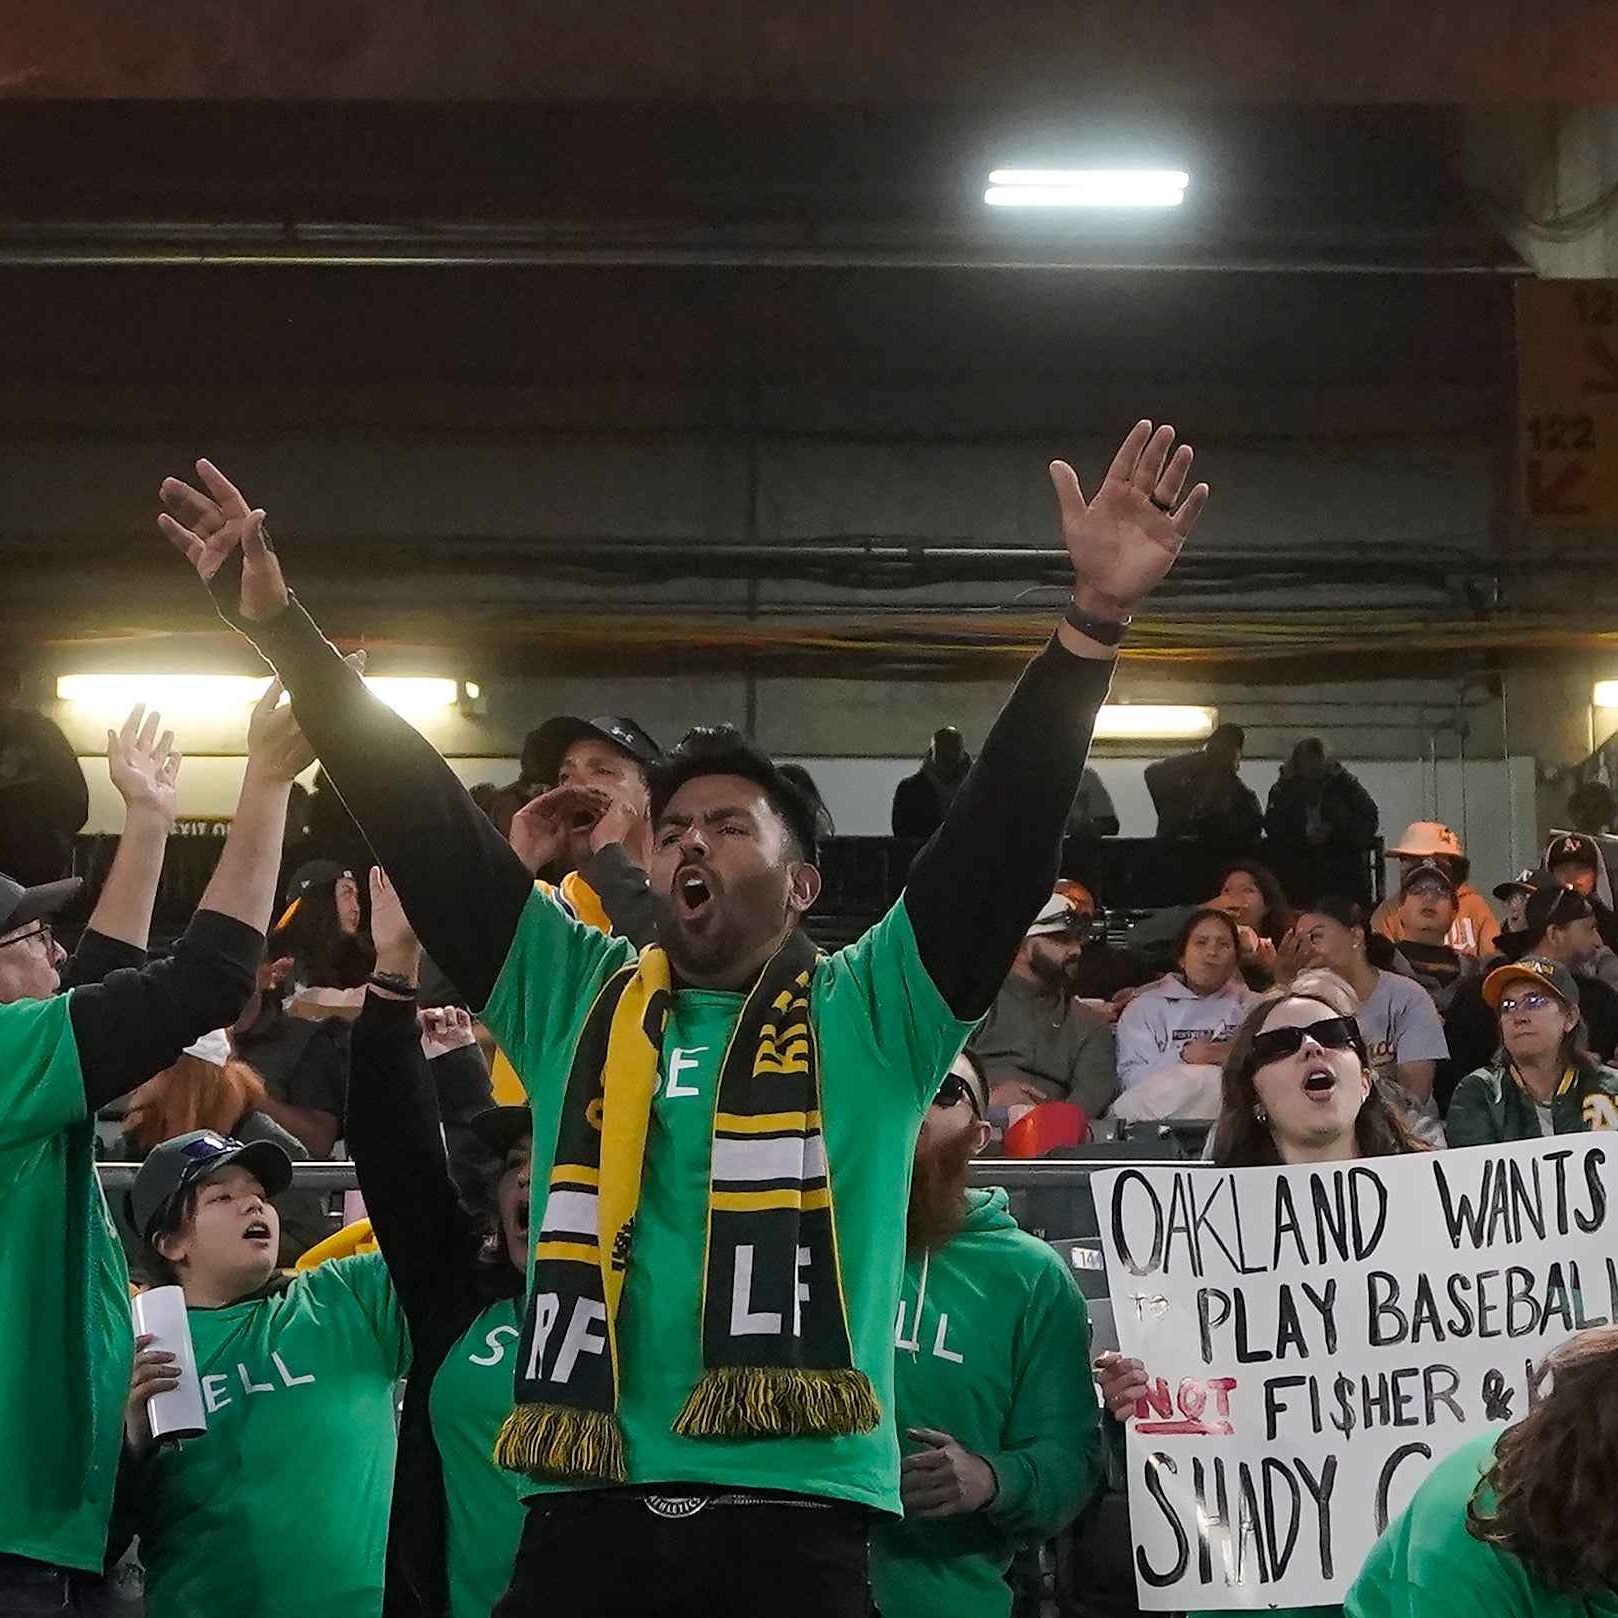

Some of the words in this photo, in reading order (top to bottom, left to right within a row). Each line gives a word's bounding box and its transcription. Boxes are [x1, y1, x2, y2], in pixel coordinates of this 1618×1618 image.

[1527, 416, 1594, 450] 122
[1111, 1166, 1388, 1277] OAKLAND
[1433, 1148, 1607, 1249] WANTS
[894, 1299, 964, 1364] LL
[1196, 1279, 1337, 1364] PLAY
[201, 1351, 316, 1414] ELL
[1133, 1377, 1238, 1424] NOT
[1481, 1368, 1514, 1421] &
[1136, 1452, 1336, 1588] SHADY
